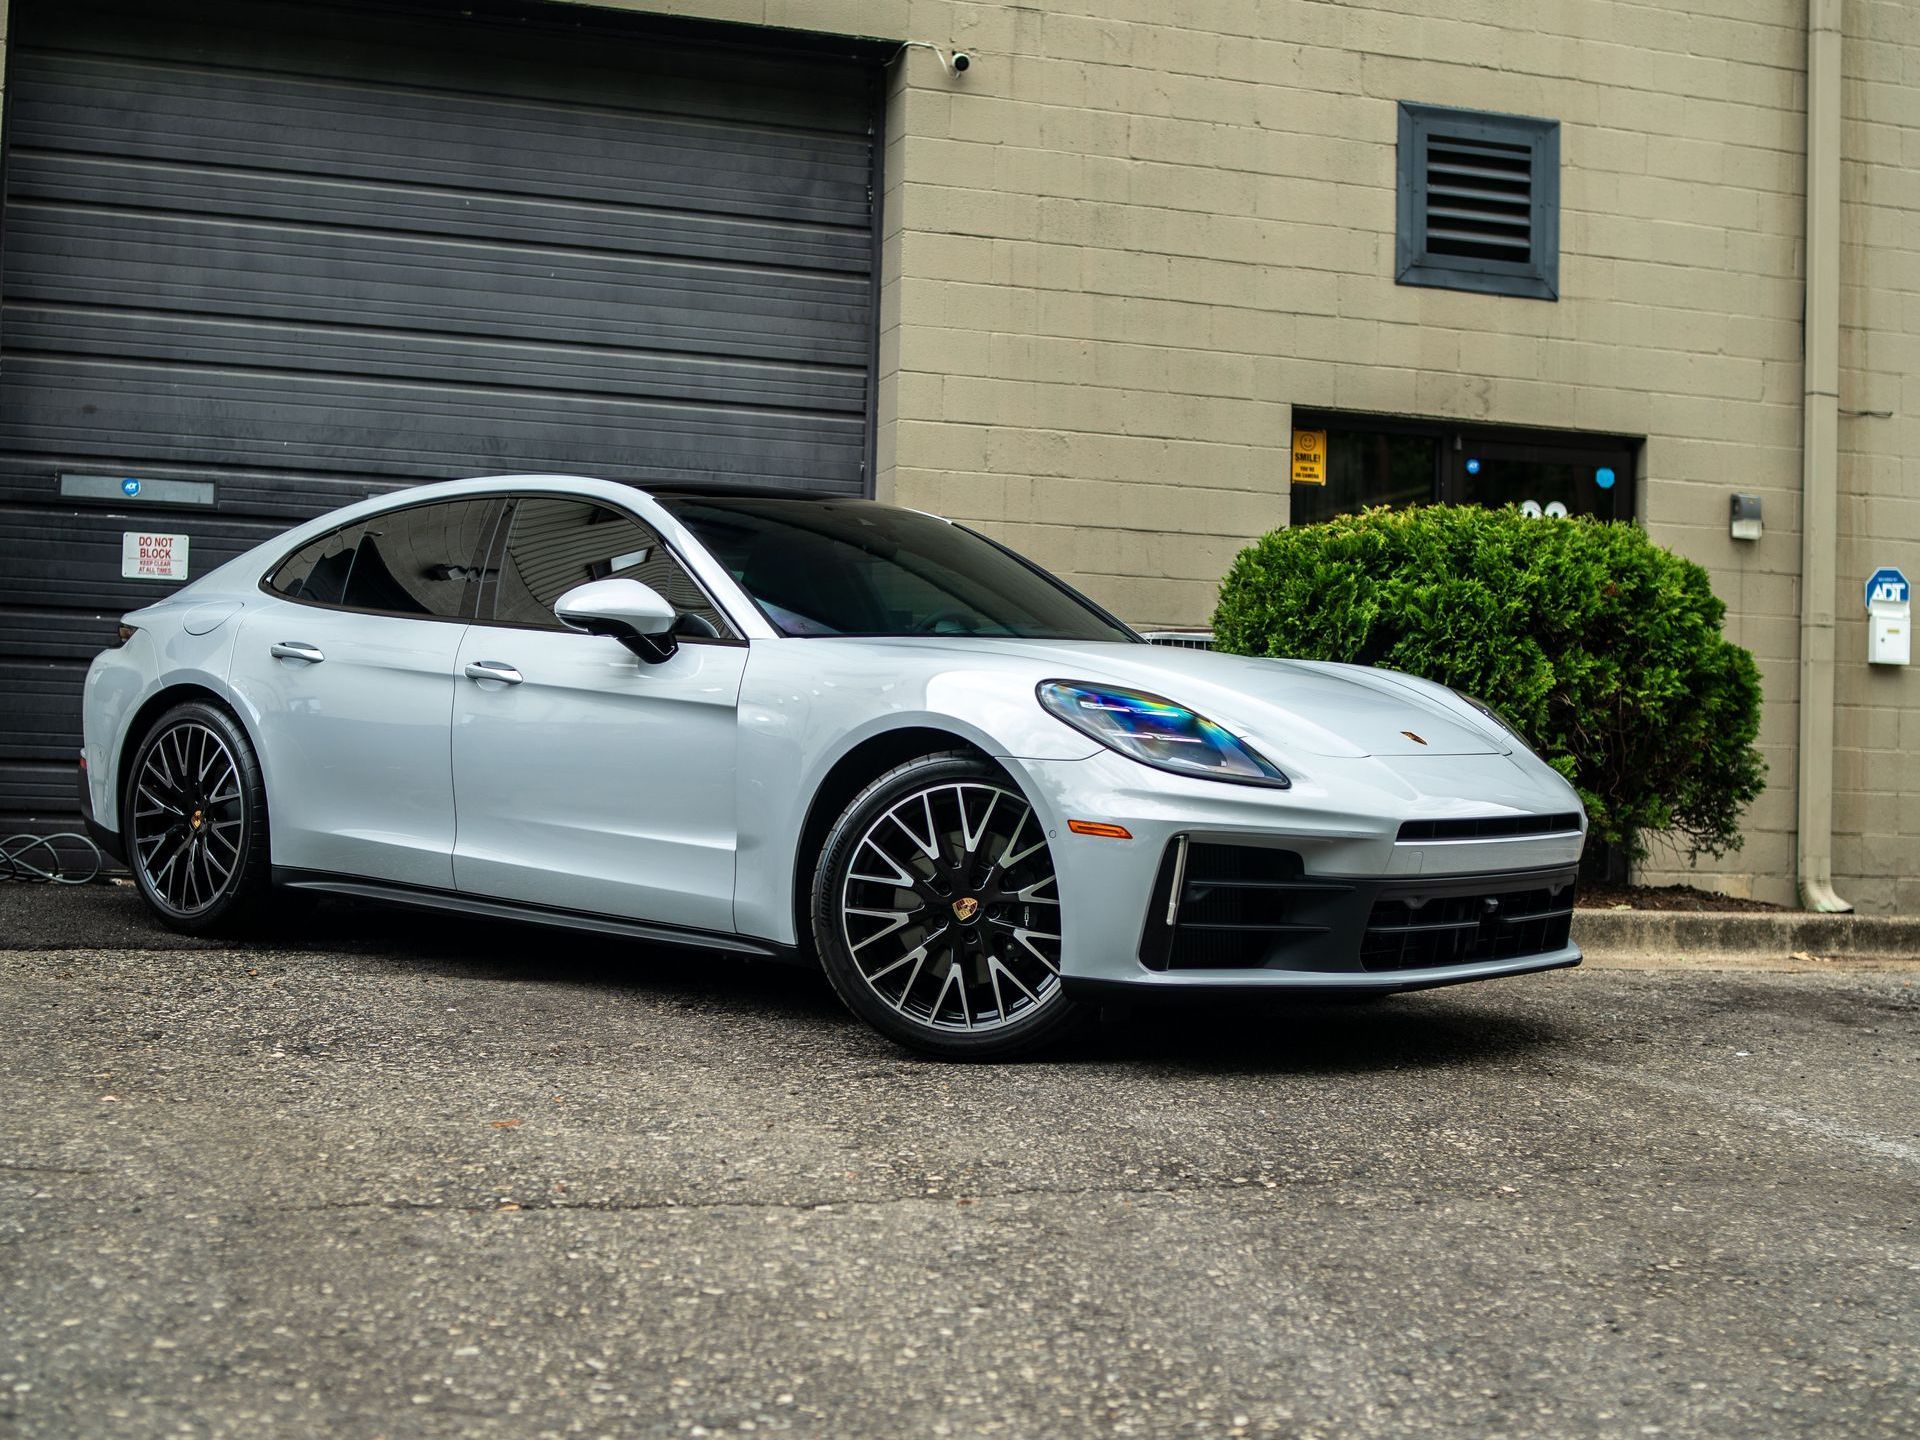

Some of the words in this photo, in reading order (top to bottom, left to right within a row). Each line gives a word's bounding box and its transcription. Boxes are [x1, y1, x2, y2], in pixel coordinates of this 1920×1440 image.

[1295, 453, 1320, 463] SMILE!
[139, 536, 152, 547] DO
[154, 537, 173, 548] NOT
[140, 548, 171, 559] BLOCK
[1872, 583, 1906, 602] ADT
